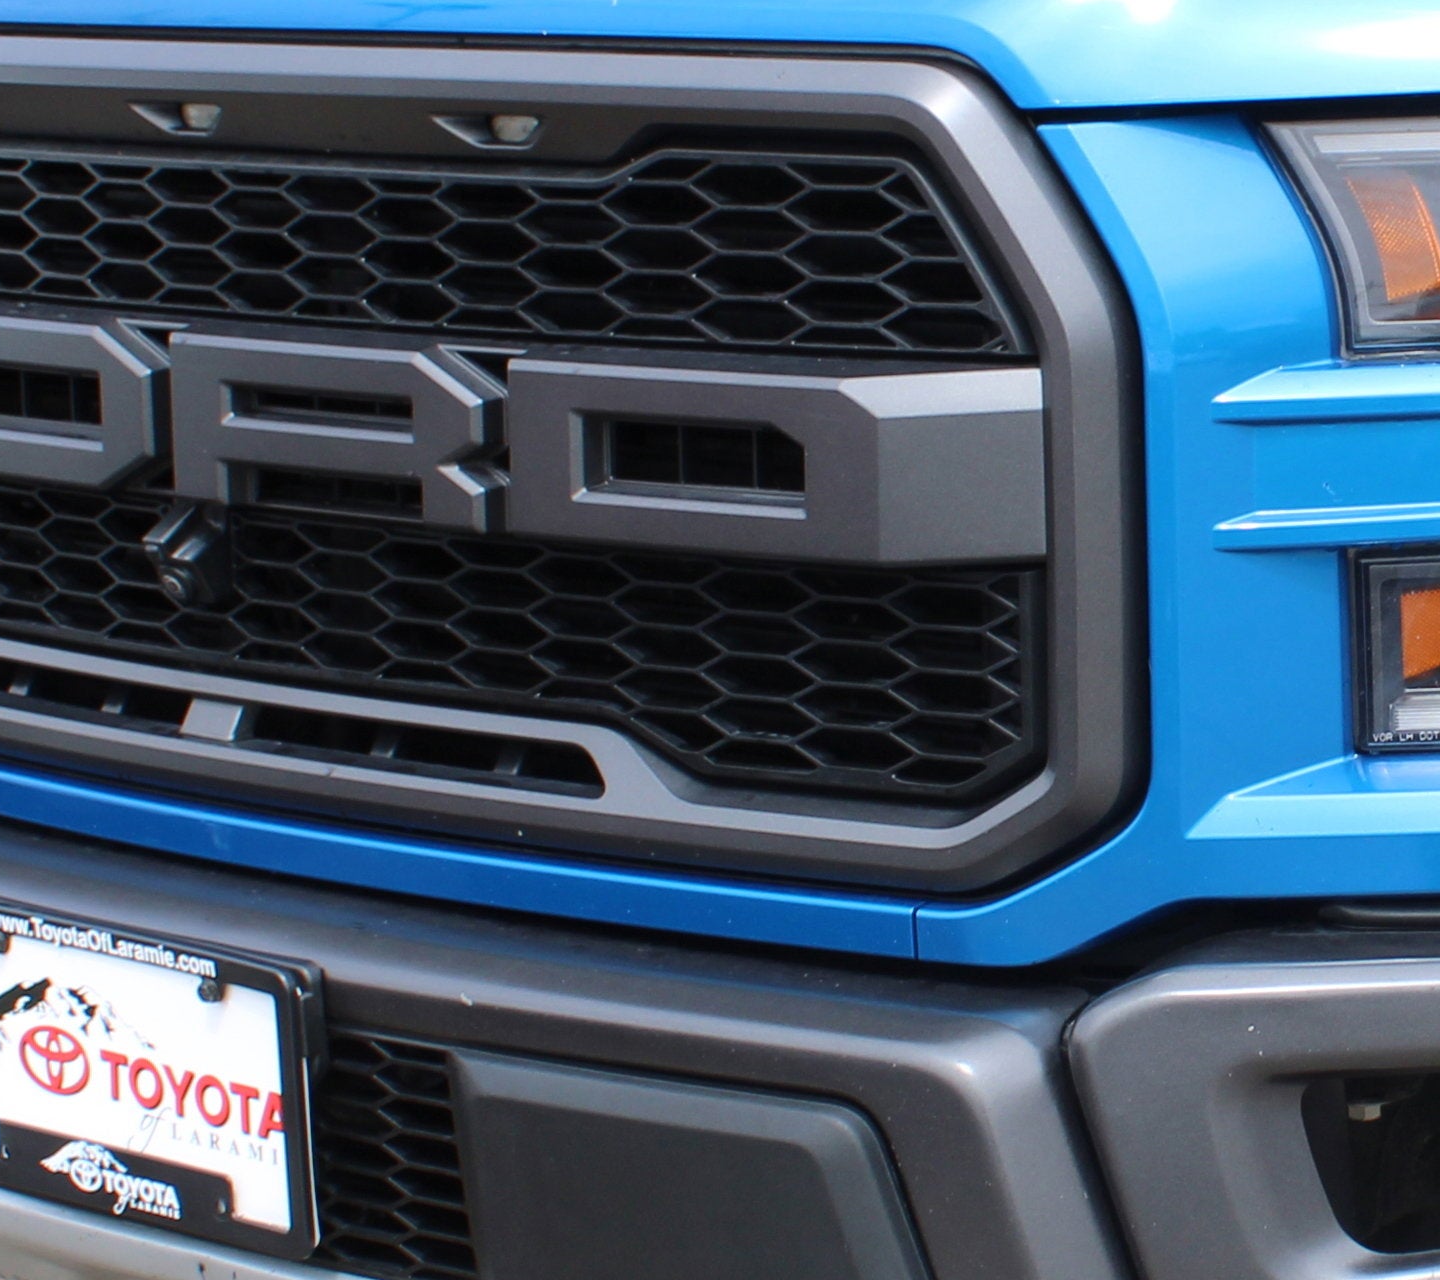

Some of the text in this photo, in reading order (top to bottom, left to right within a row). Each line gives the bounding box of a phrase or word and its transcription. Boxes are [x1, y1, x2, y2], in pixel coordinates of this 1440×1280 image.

[100, 1048, 284, 1140] TOYOTA
[171, 1122, 279, 1166] LARAMI
[103, 1169, 181, 1209] TOYOTA
